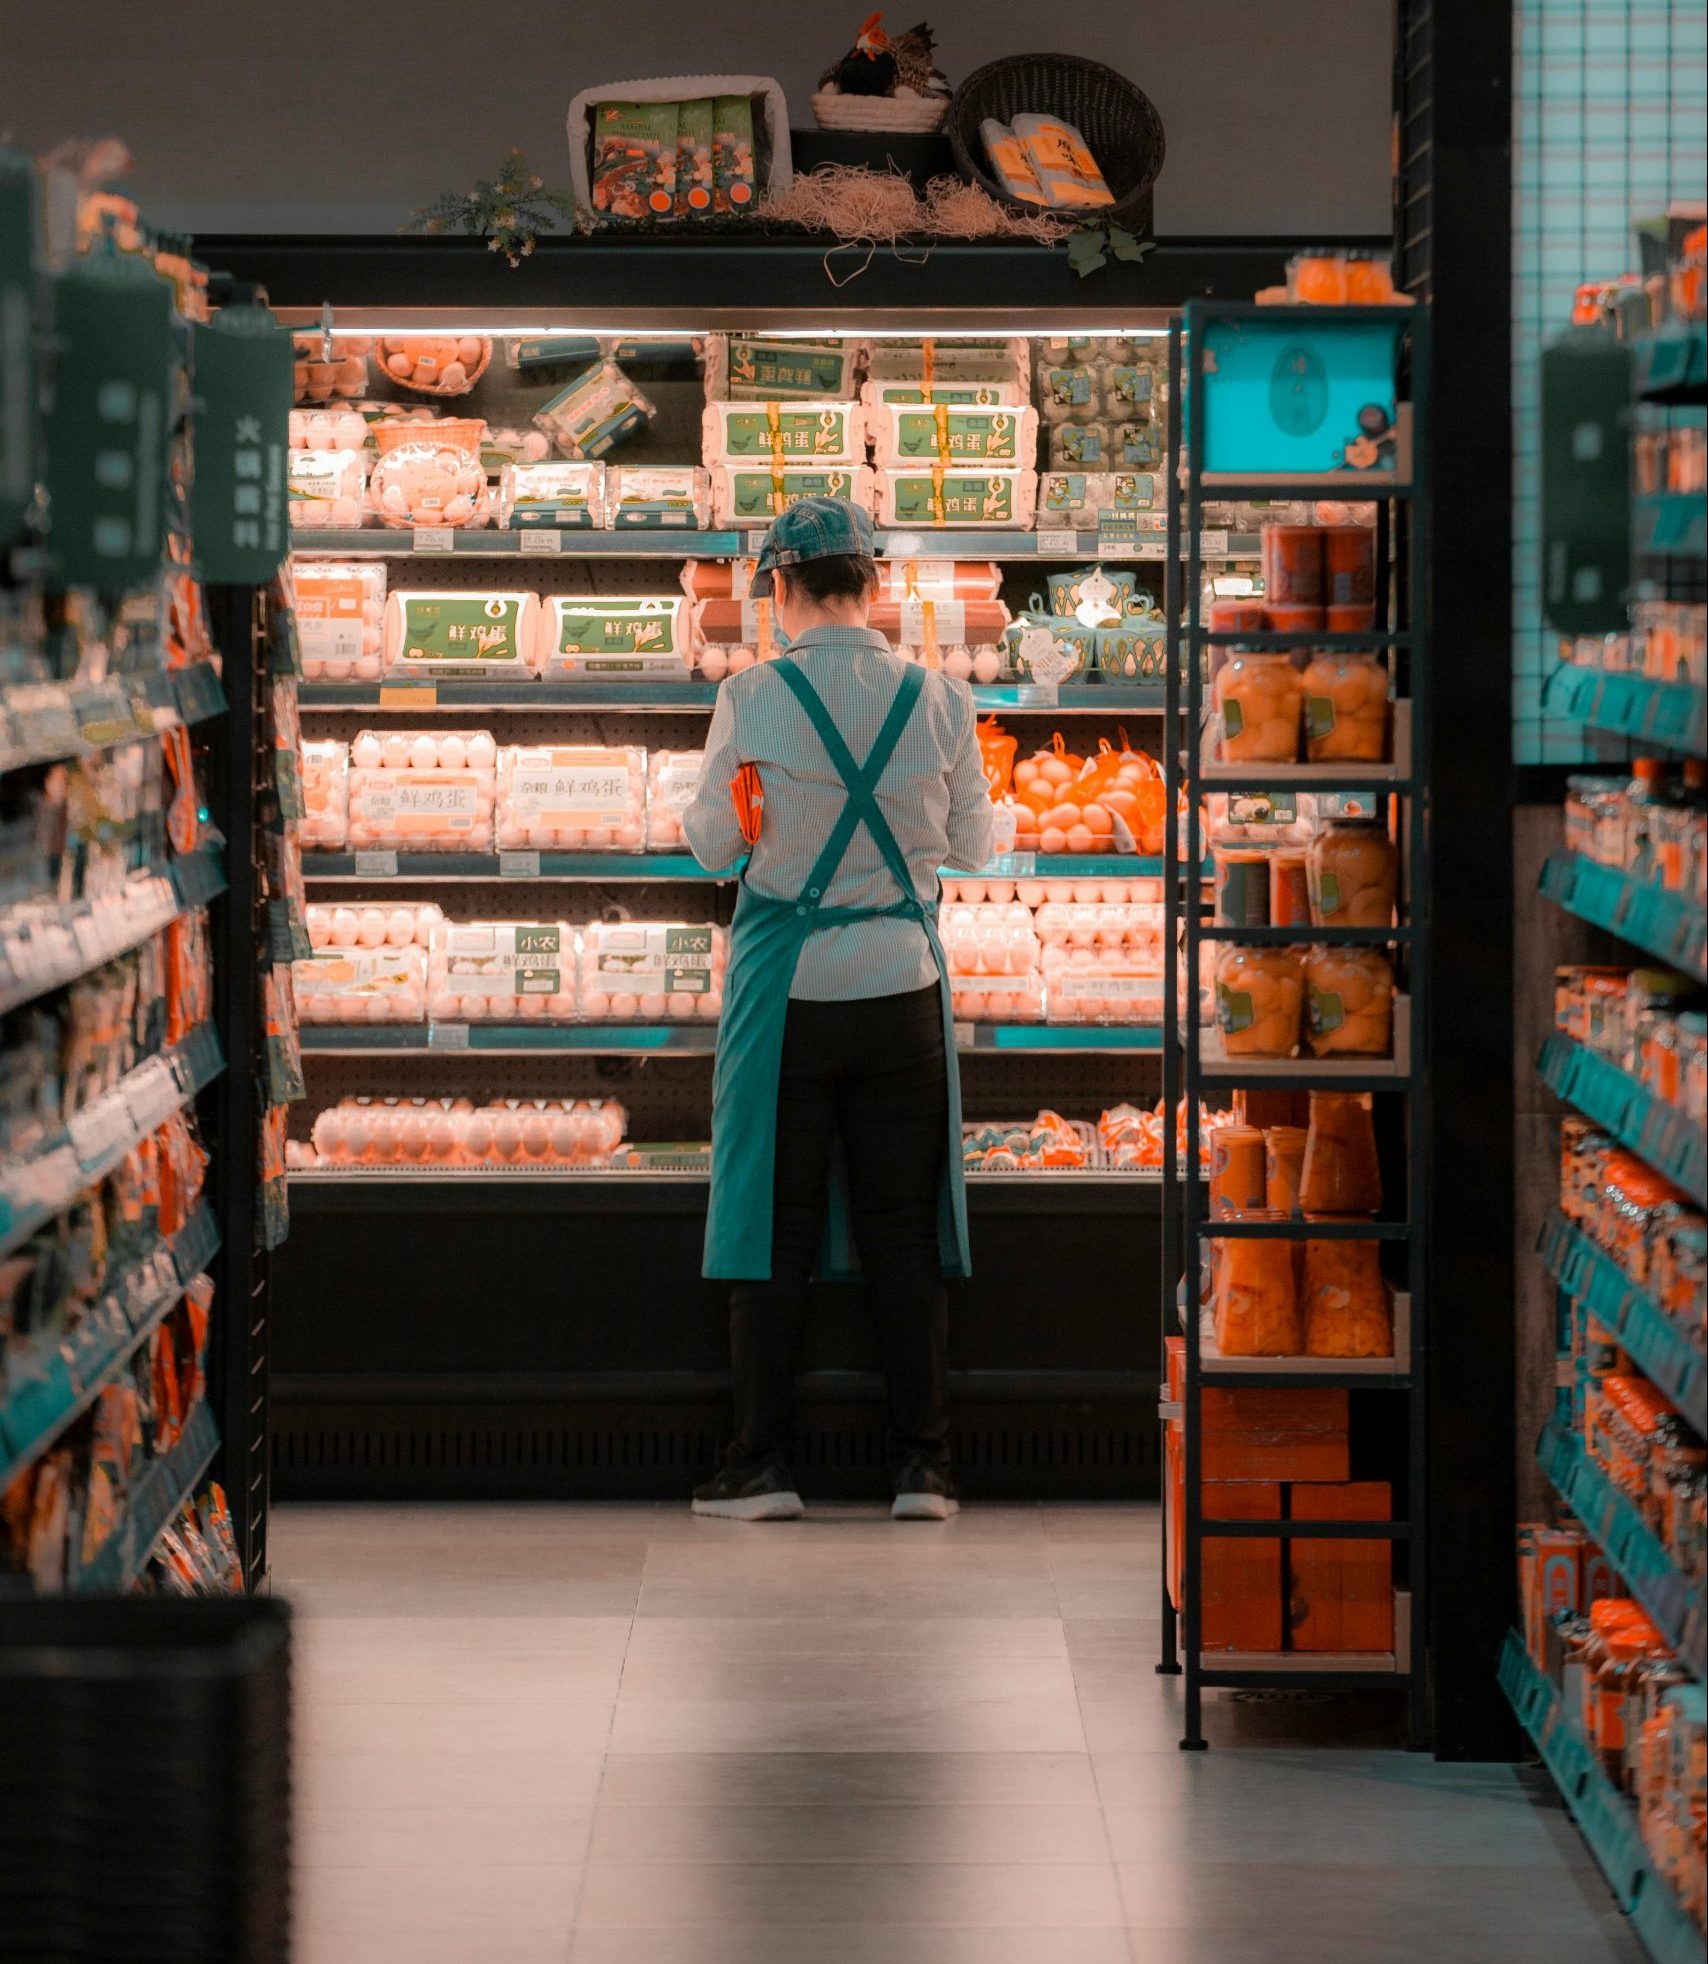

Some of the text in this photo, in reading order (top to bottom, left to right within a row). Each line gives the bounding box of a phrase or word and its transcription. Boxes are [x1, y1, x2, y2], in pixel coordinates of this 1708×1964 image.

[448, 624, 507, 641] 鲜鸡蛋
[604, 621, 663, 637] 鲜鸡蛋
[555, 779, 623, 797] 鲜鸡蛋
[400, 788, 467, 808] 鲜鸡蛋
[520, 935, 556, 951] 小农
[671, 936, 708, 951] 小农
[503, 954, 557, 969] 鲜鸡蛋
[654, 953, 707, 968] 鲜鸡蛋
